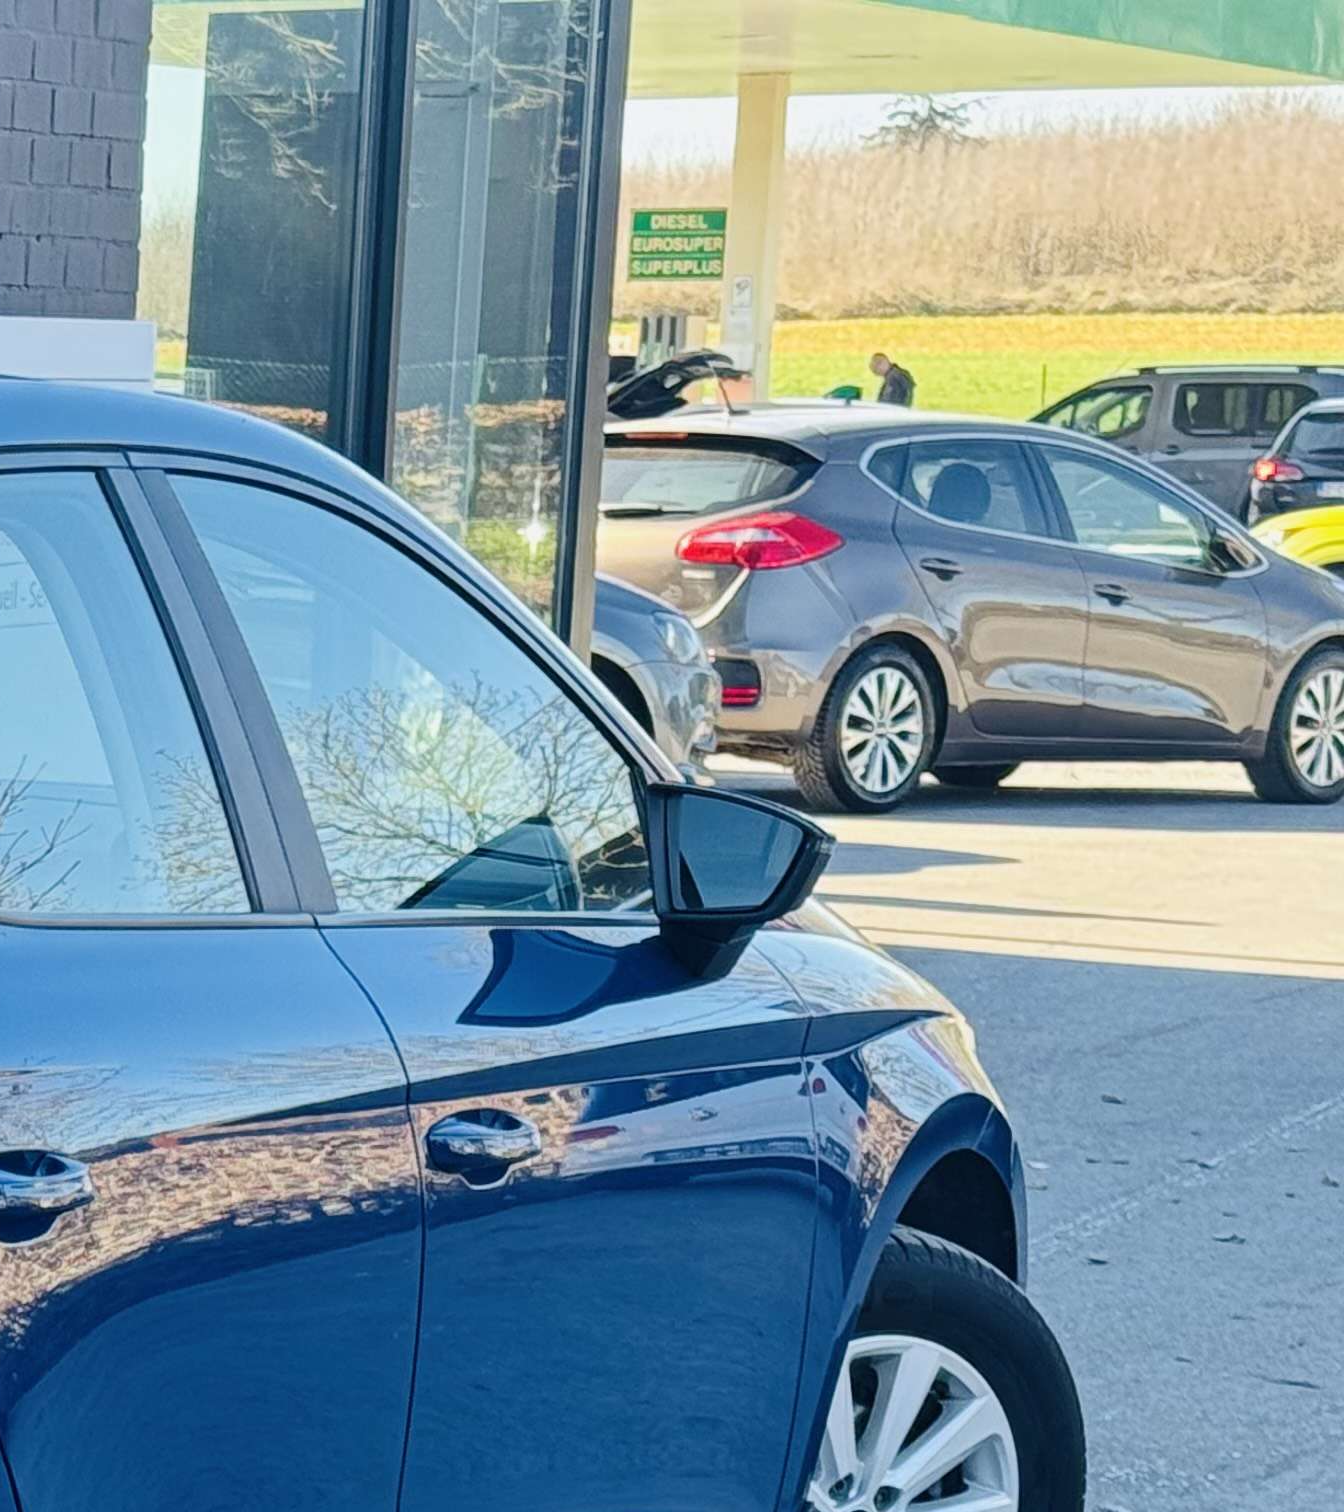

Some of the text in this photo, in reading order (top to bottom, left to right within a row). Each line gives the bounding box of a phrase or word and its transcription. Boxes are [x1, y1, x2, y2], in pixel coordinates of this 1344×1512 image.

[651, 215, 708, 230] DIESEL
[633, 237, 723, 252] EUROSUPER
[632, 260, 722, 275] SUPERPLUS
